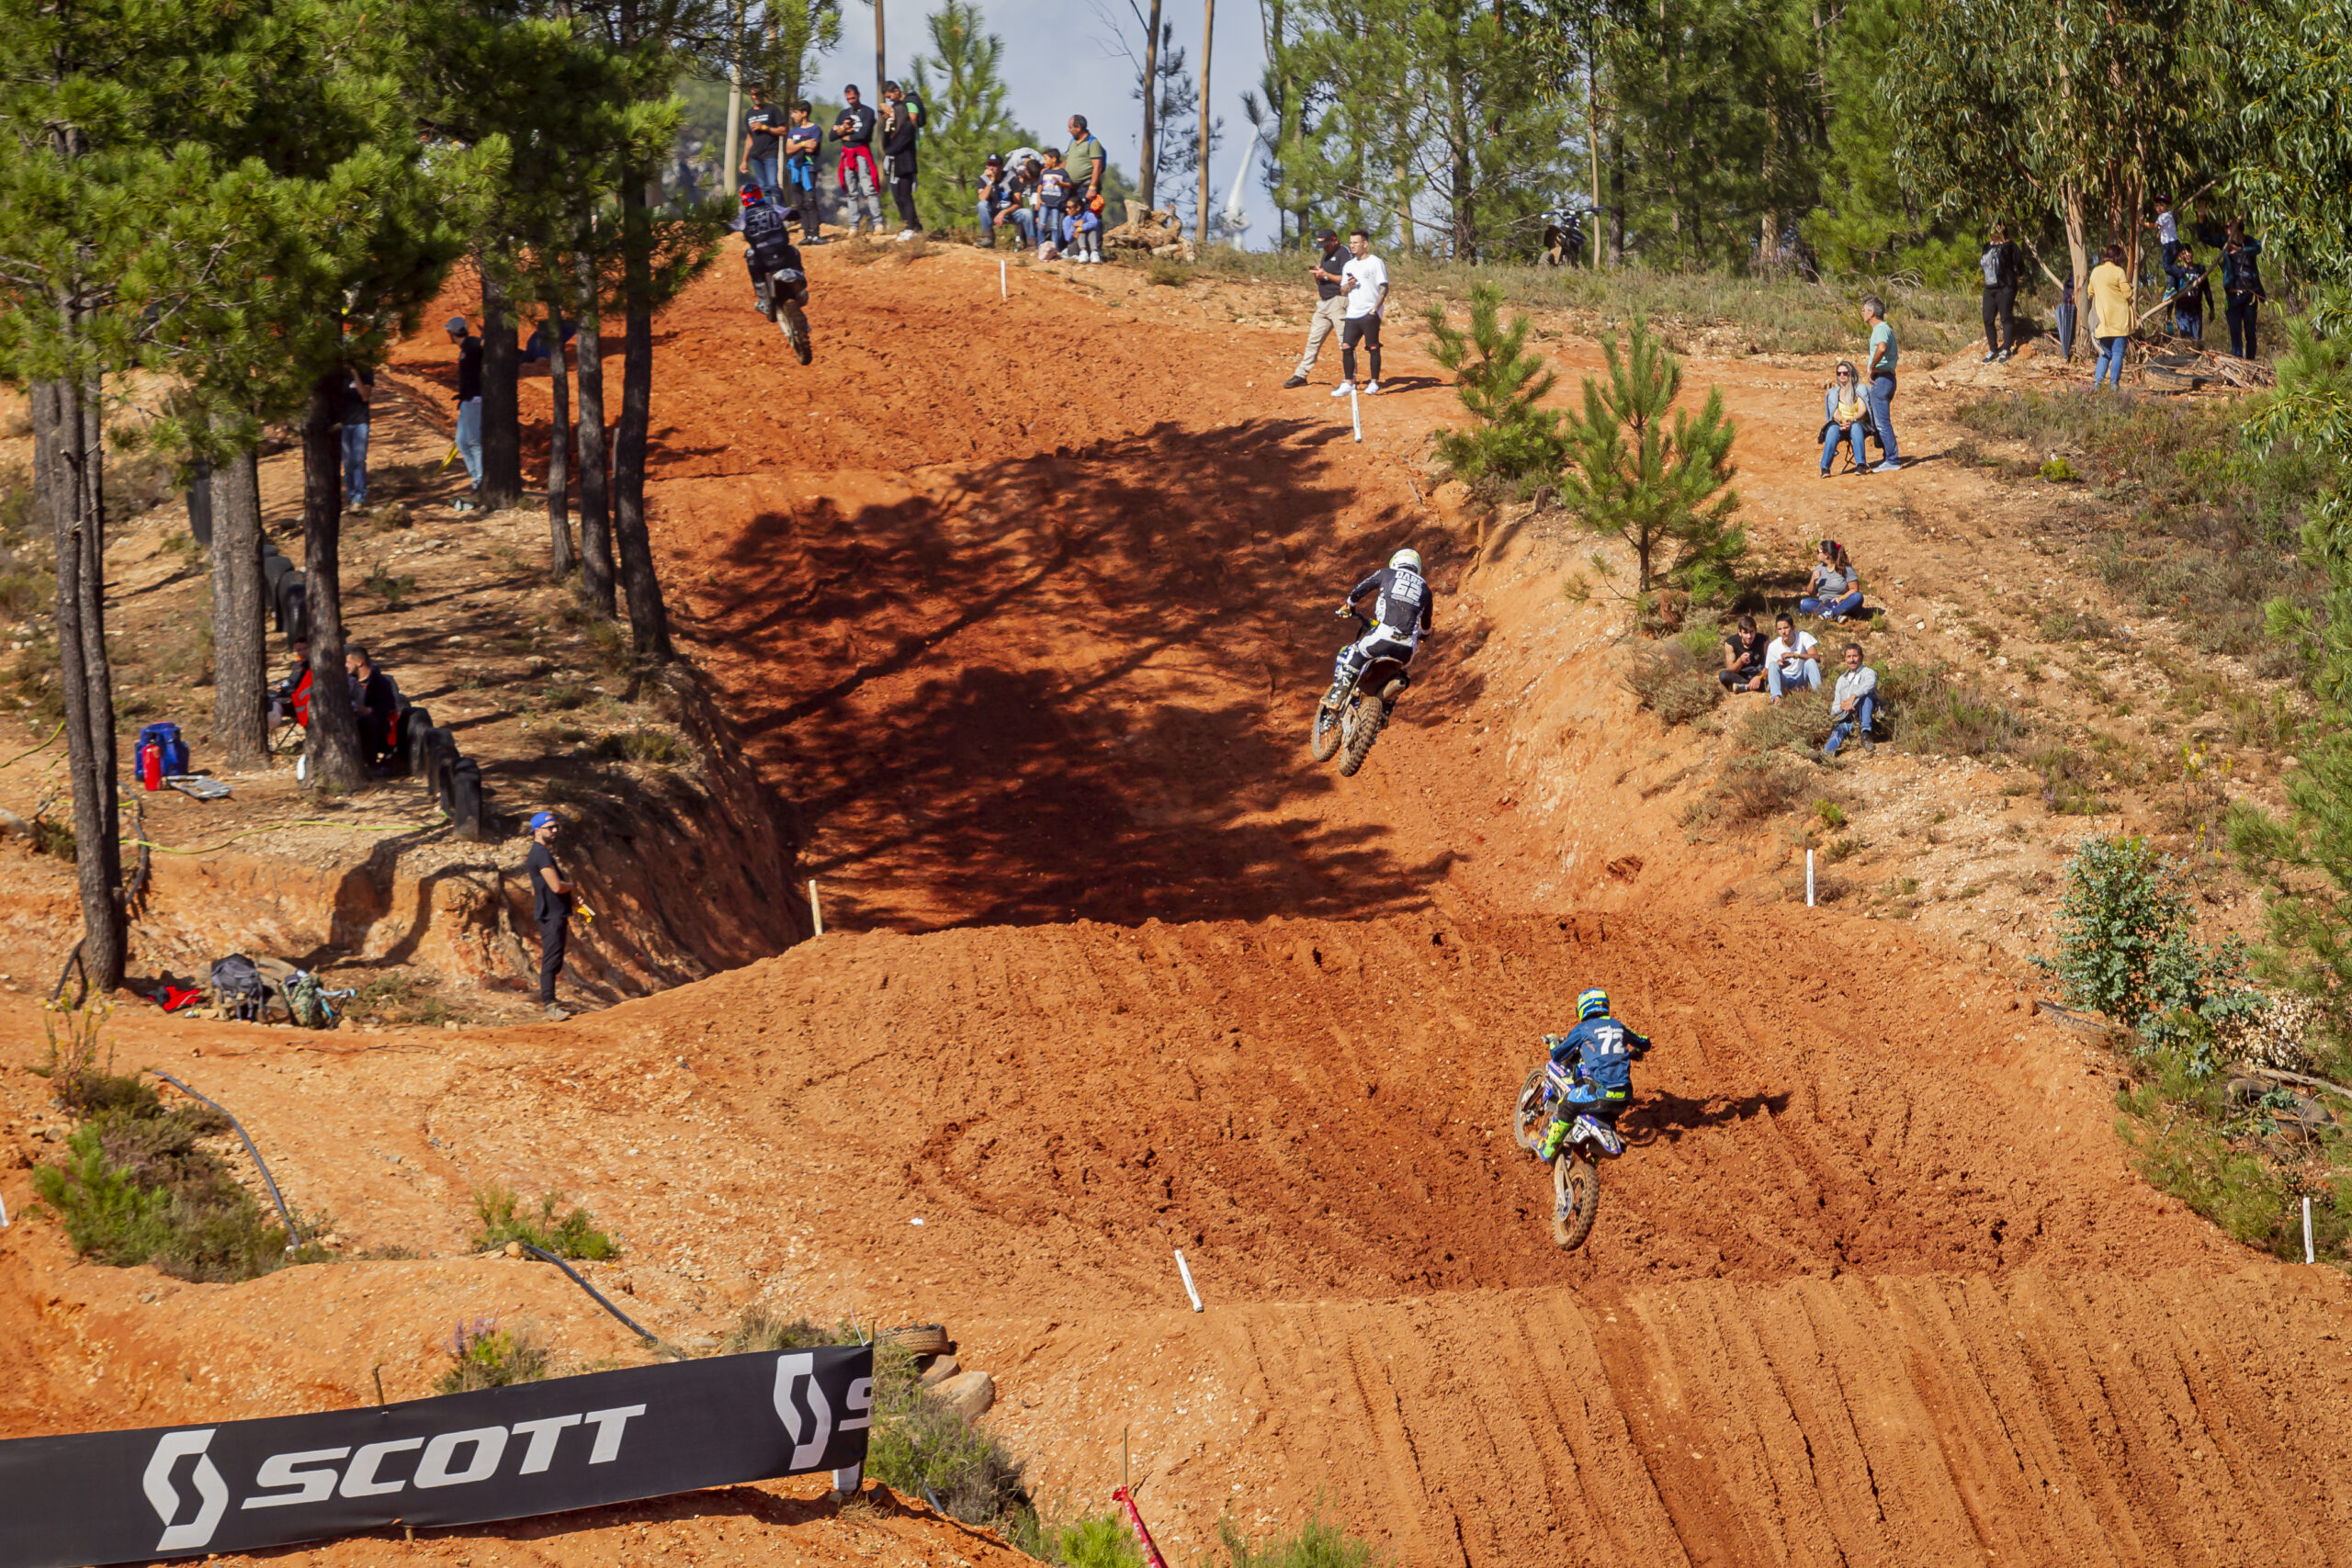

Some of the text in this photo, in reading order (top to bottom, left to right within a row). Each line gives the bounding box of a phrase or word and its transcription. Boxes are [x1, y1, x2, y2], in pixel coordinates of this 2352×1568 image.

[1395, 570, 1423, 586] DARK
[1391, 578, 1422, 602] 62
[1598, 1032, 1625, 1055] 72
[241, 1404, 647, 1510] SCOTT
